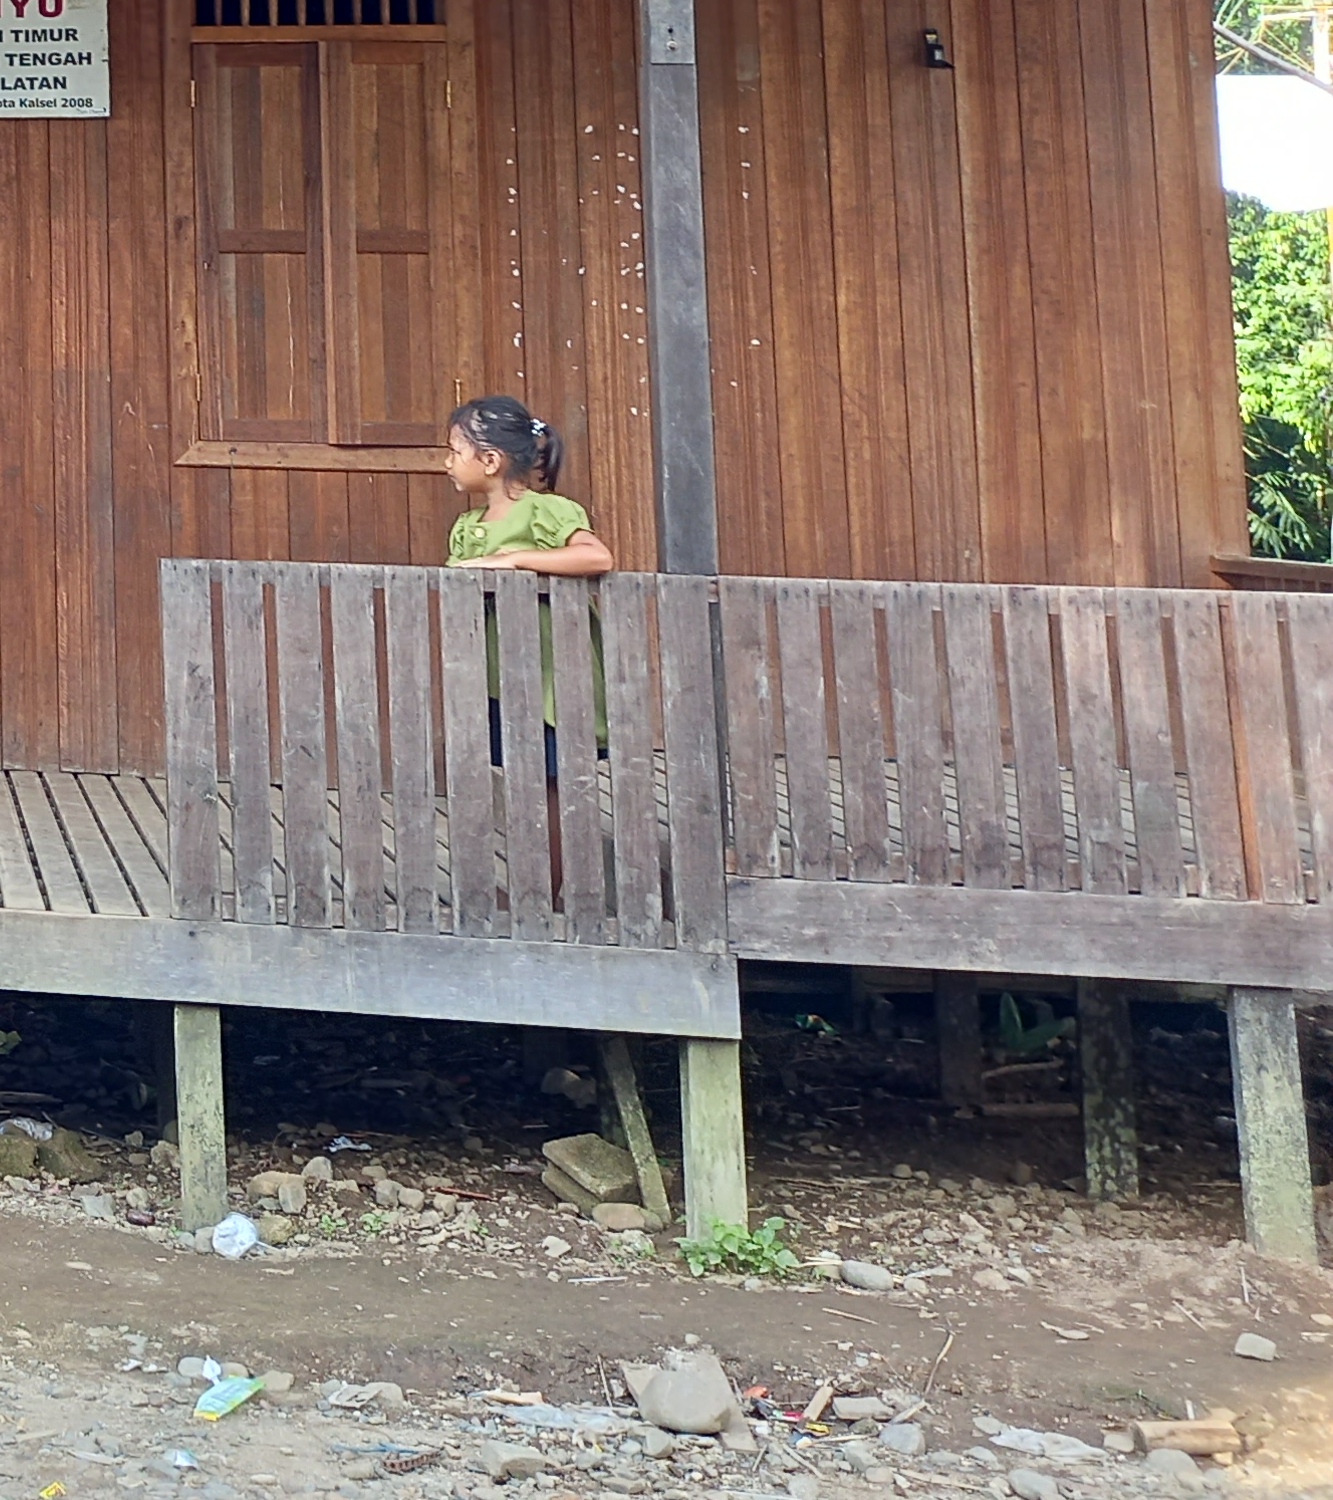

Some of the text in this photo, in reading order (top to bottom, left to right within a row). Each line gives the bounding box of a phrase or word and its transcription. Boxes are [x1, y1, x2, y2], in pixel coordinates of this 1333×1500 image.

[9, 28, 79, 42] TIMUR
[5, 52, 93, 67] TENGAH
[19, 98, 57, 108] Kalsel
[60, 97, 93, 108] 2008
